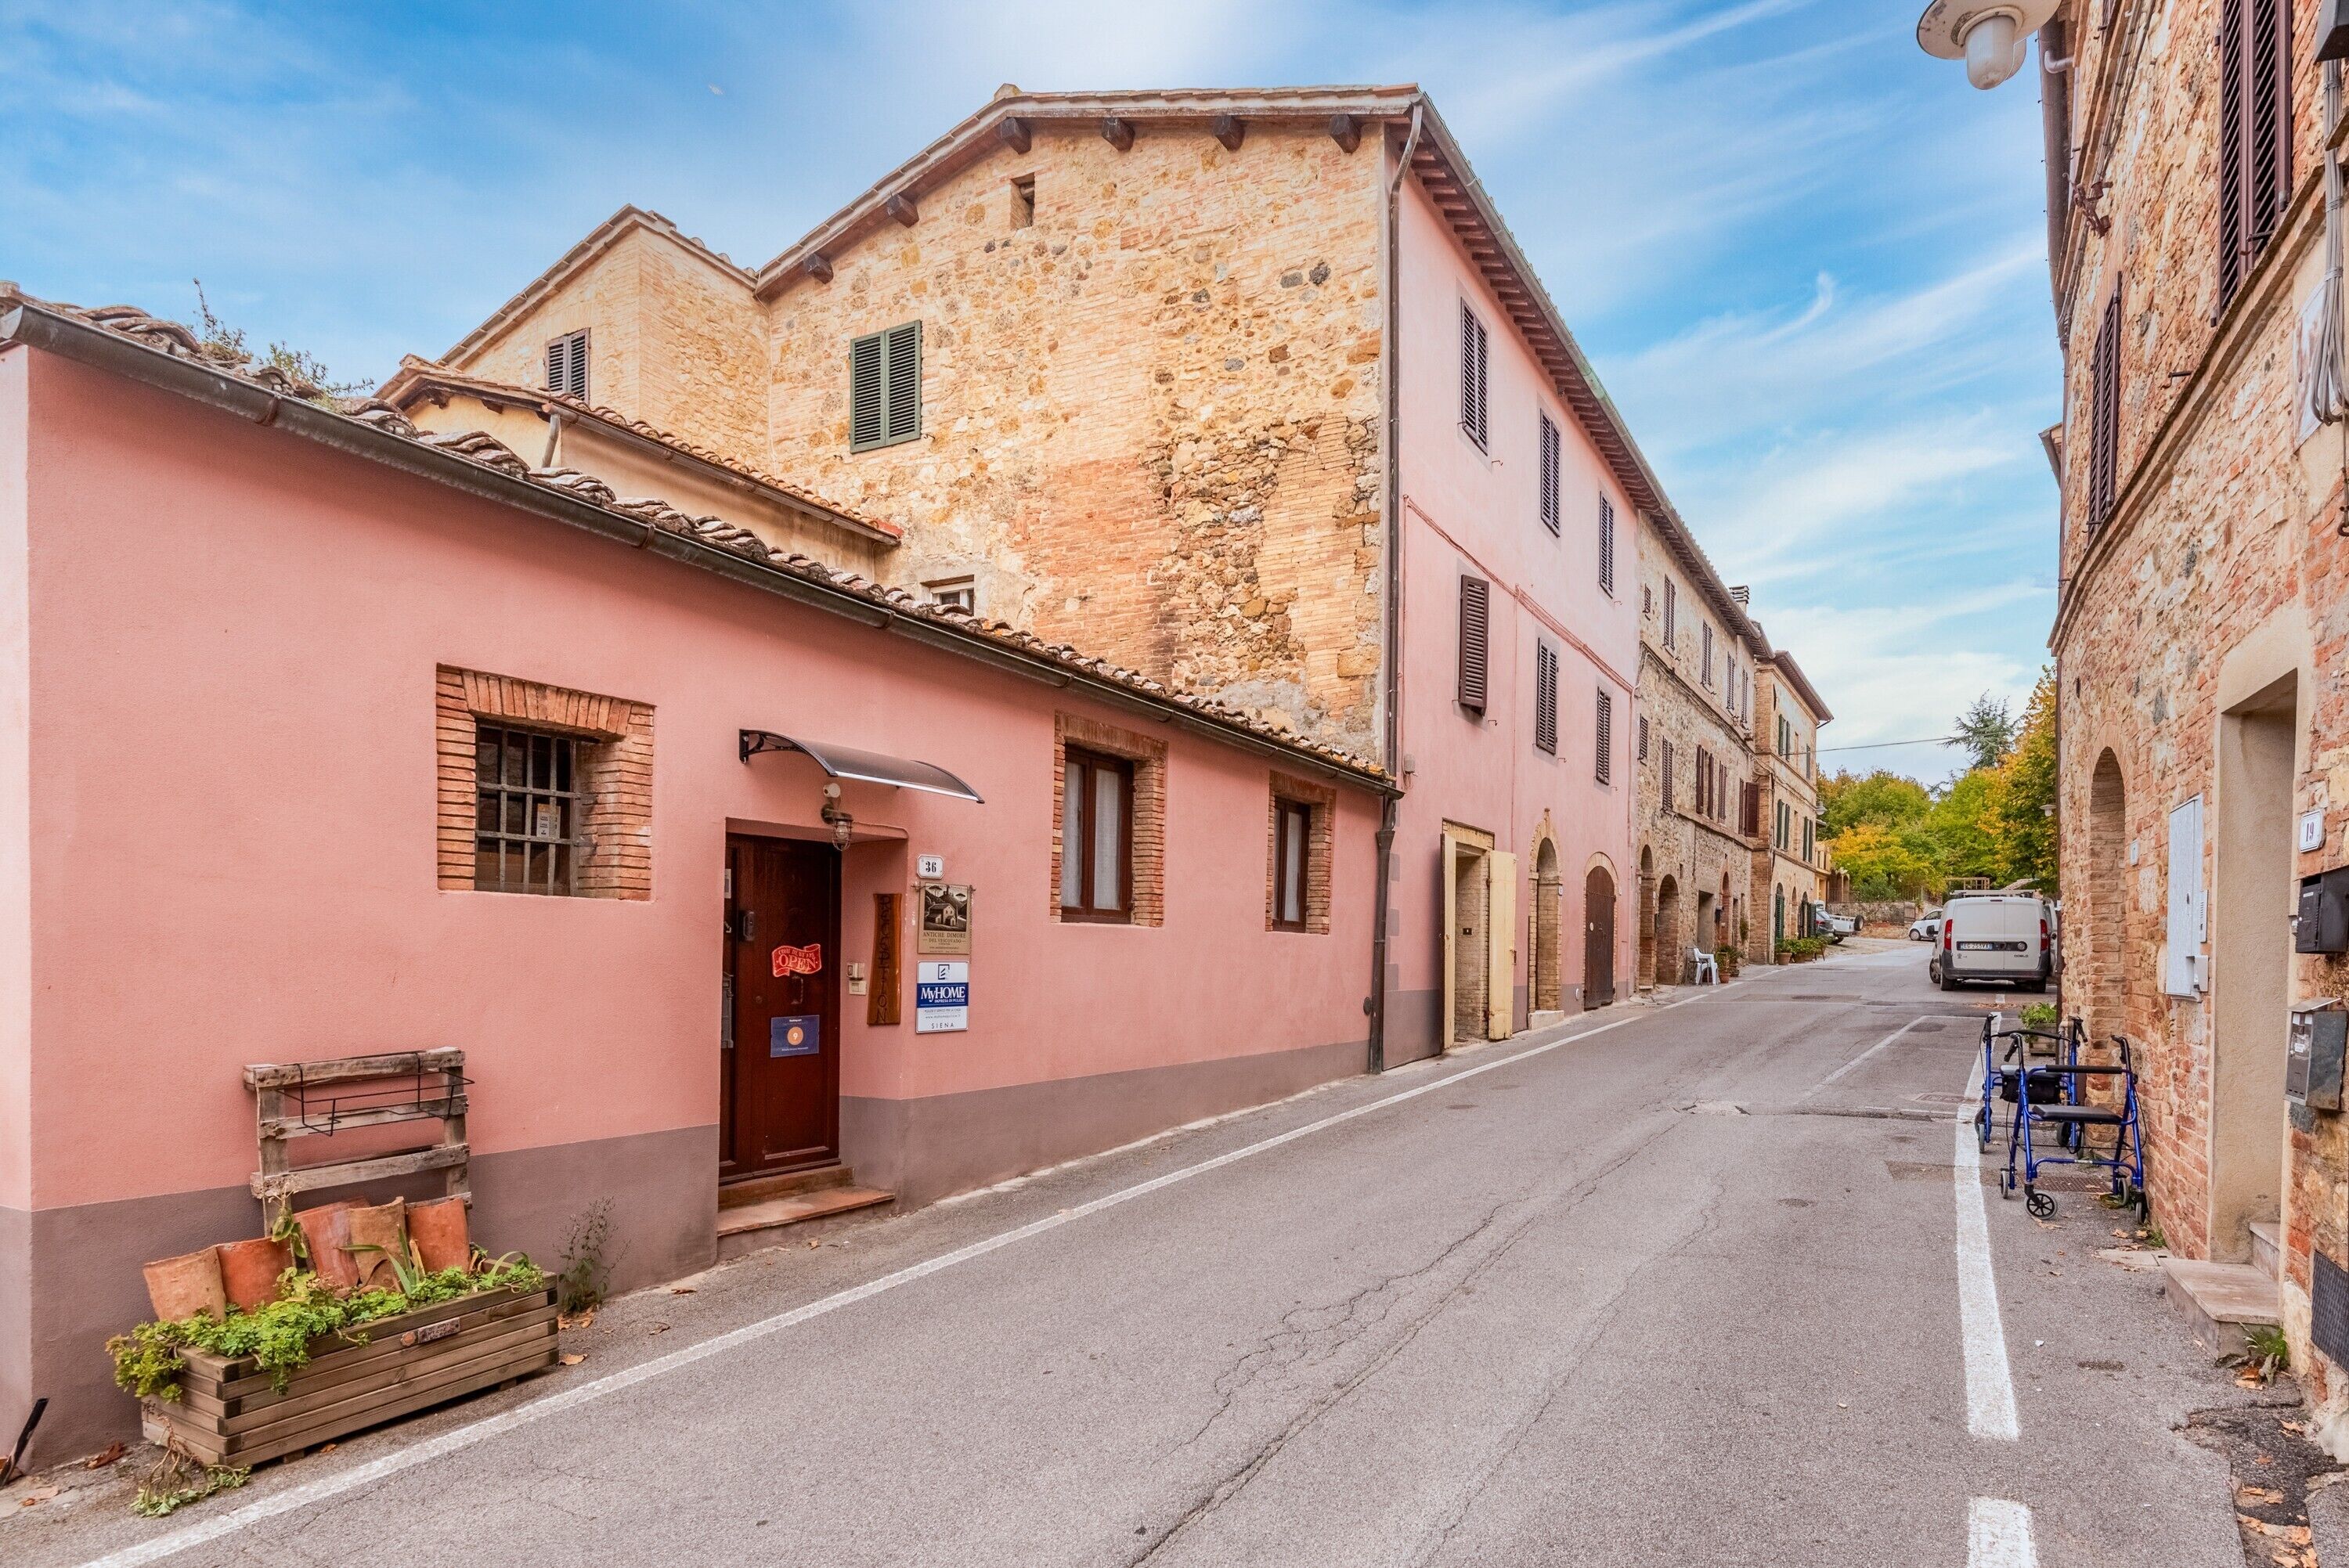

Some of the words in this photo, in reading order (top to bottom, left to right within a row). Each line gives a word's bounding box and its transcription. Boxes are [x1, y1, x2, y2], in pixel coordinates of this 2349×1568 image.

[2306, 822, 2314, 842] 19
[926, 861, 936, 872] 36
[778, 954, 816, 970] OPEN
[921, 986, 965, 1003] MyHOME
